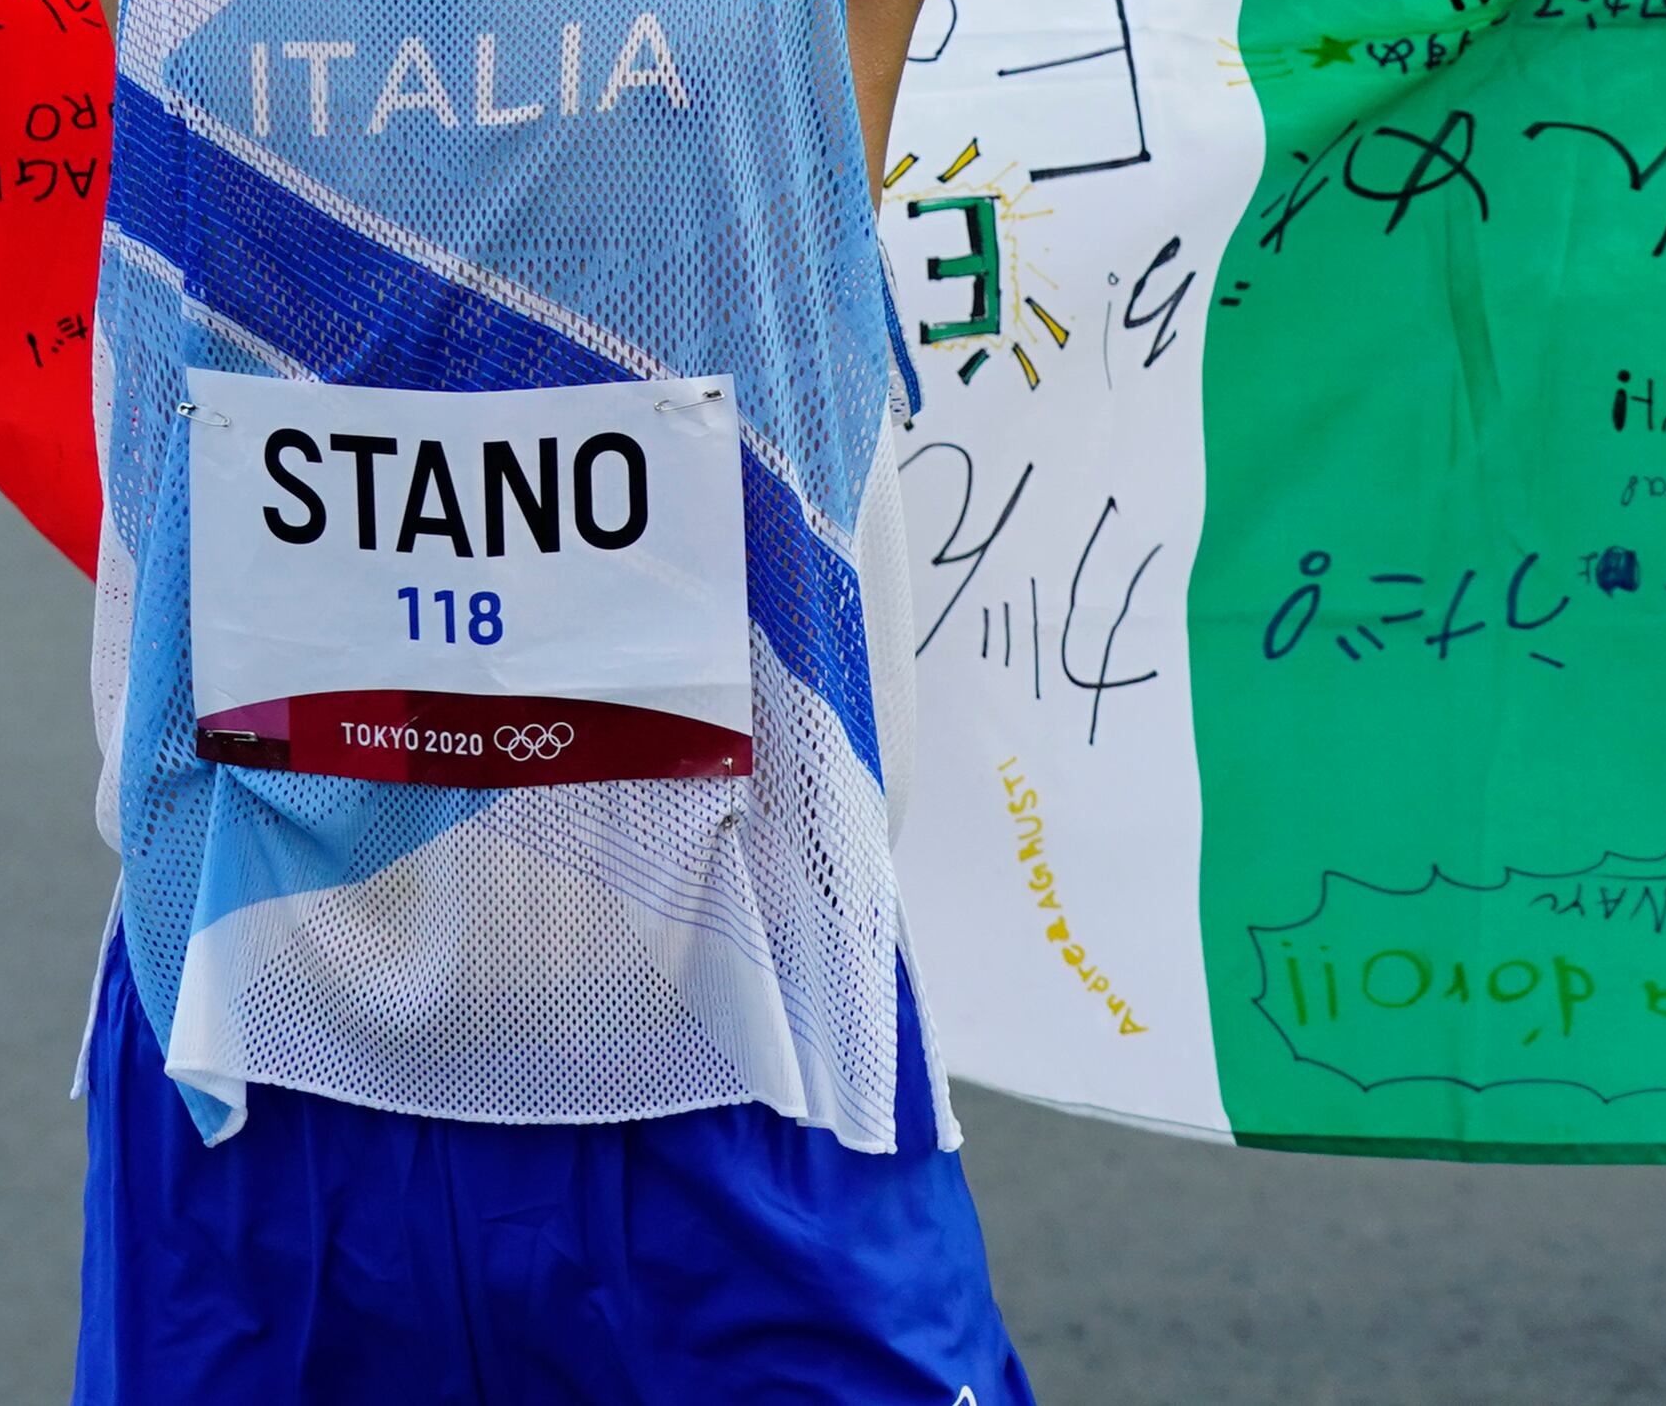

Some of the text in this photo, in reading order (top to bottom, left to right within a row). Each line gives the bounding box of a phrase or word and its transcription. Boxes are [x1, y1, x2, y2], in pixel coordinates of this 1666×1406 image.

[250, 13, 690, 138] ITALIA
[262, 428, 649, 558] STANO
[397, 587, 504, 646] 118
[341, 722, 483, 757] TOKYO 2020
[1045, 916, 1149, 1035] Andrea
